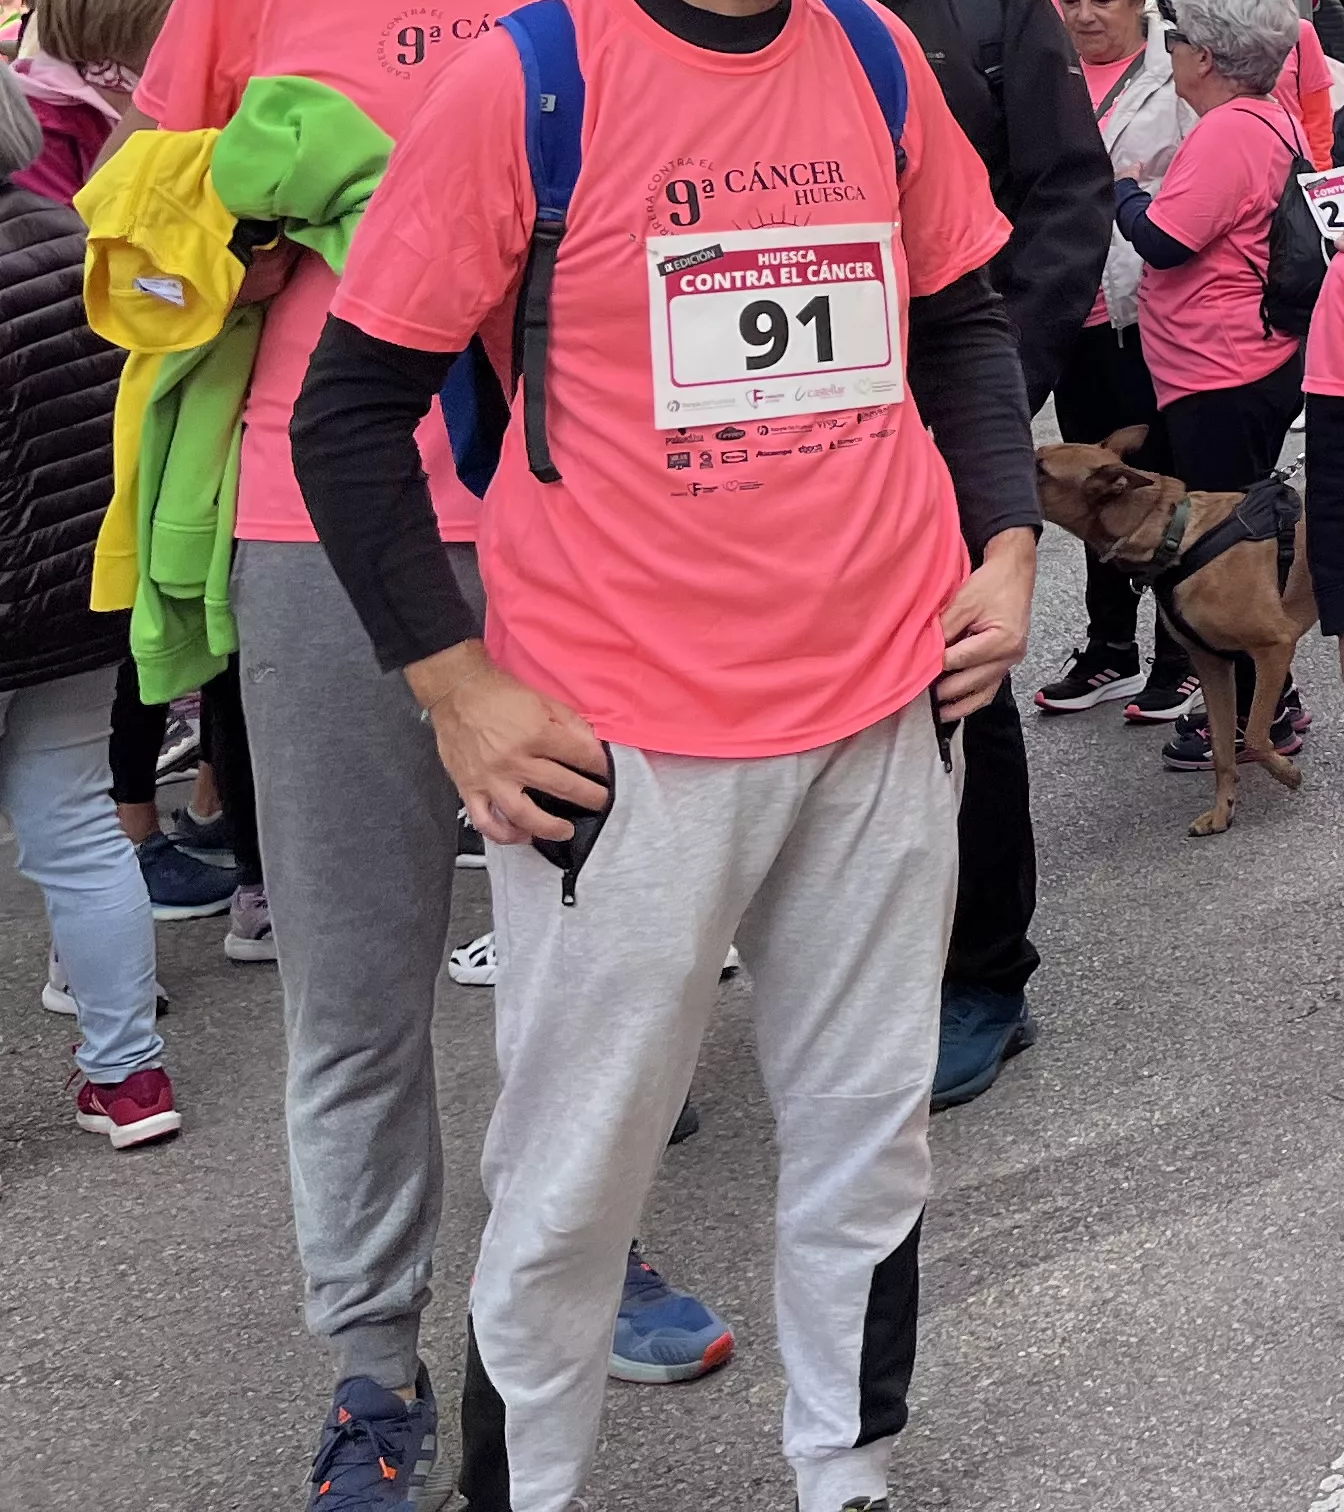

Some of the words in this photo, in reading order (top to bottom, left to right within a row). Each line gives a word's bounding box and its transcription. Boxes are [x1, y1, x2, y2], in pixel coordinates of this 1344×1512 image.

[724, 161, 845, 194] CÁNCER
[793, 185, 867, 206] HUESCA
[757, 249, 817, 267] HUESCA
[679, 271, 776, 293] CONTRA
[779, 267, 803, 285] EL
[806, 261, 876, 281] CÁNCER
[737, 294, 836, 372] 91
